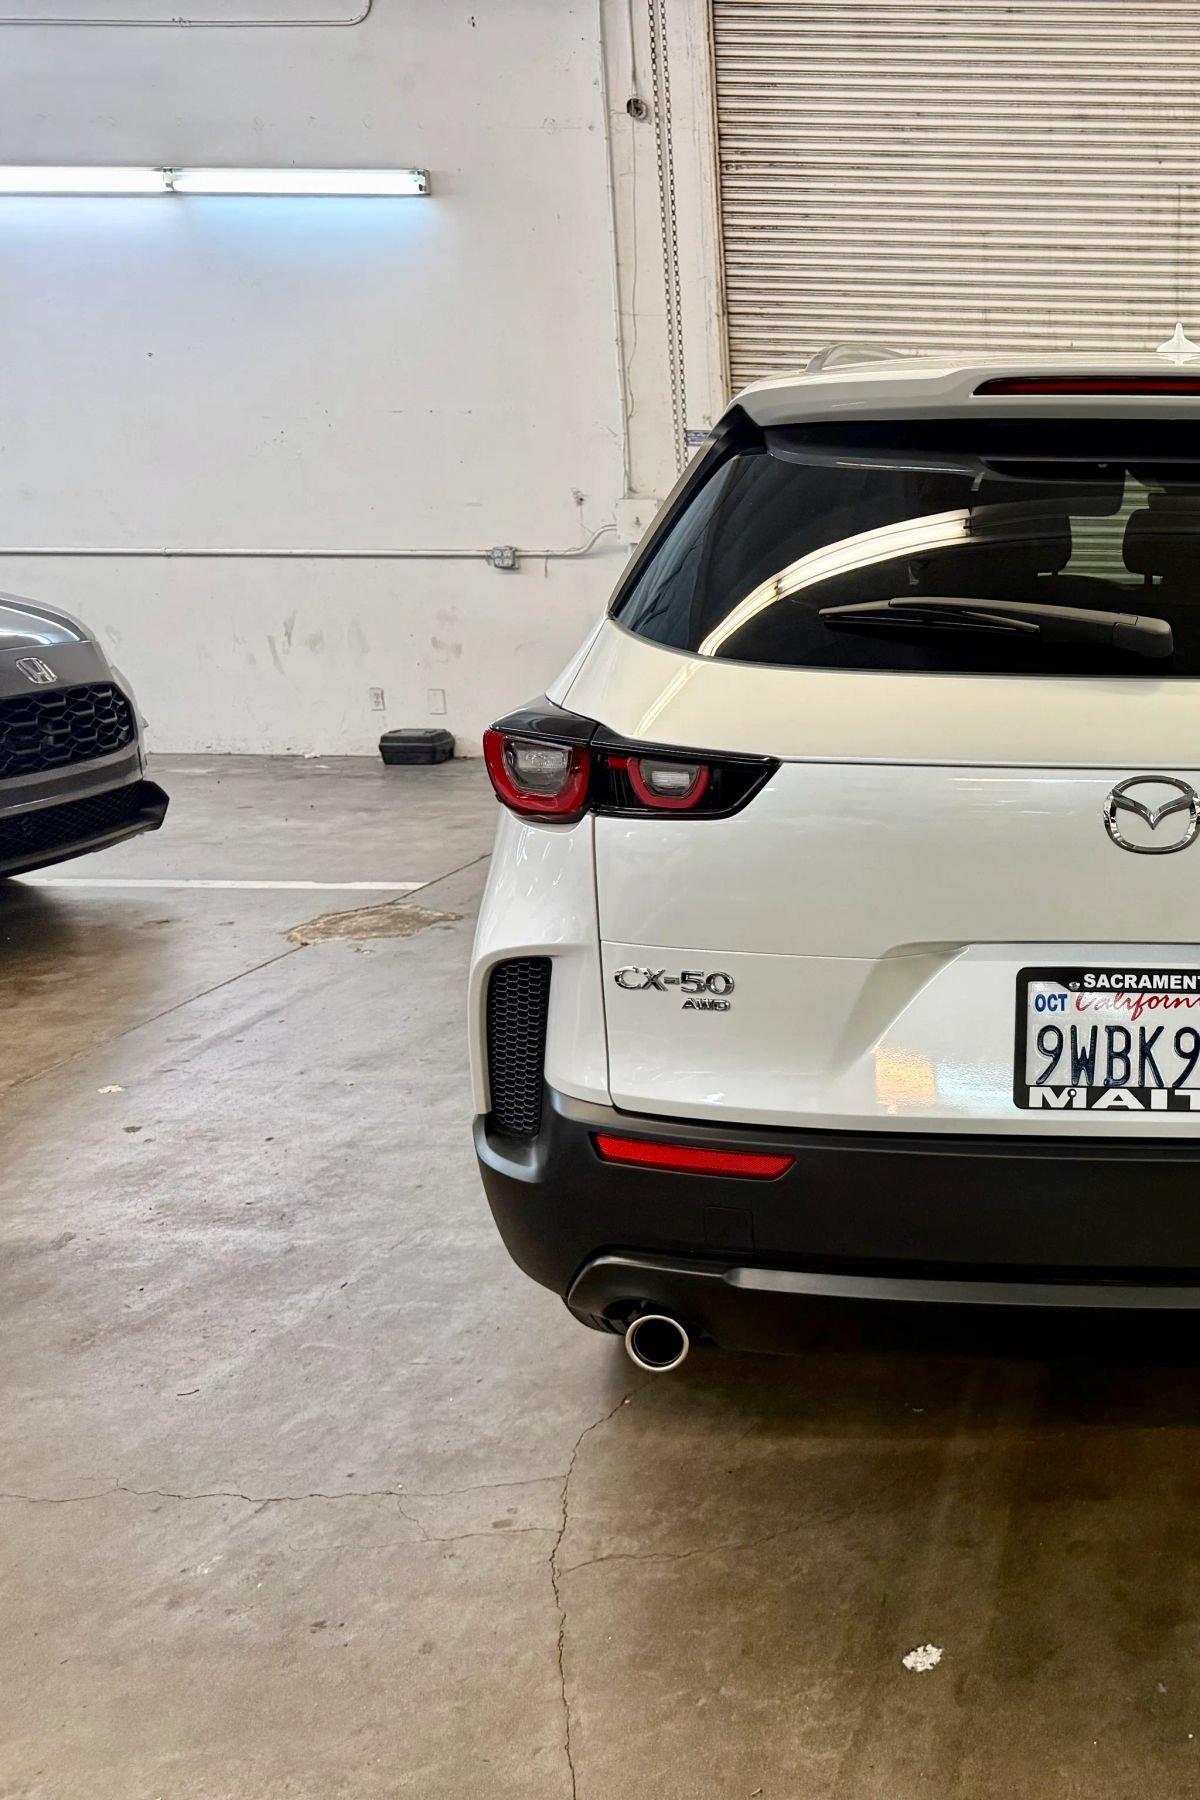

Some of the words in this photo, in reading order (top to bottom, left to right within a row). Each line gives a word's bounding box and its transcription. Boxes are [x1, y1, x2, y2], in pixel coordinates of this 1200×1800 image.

[614, 966, 735, 995] CX-50
[682, 998, 731, 1012] AWD
[1035, 993, 1067, 1012] OCT
